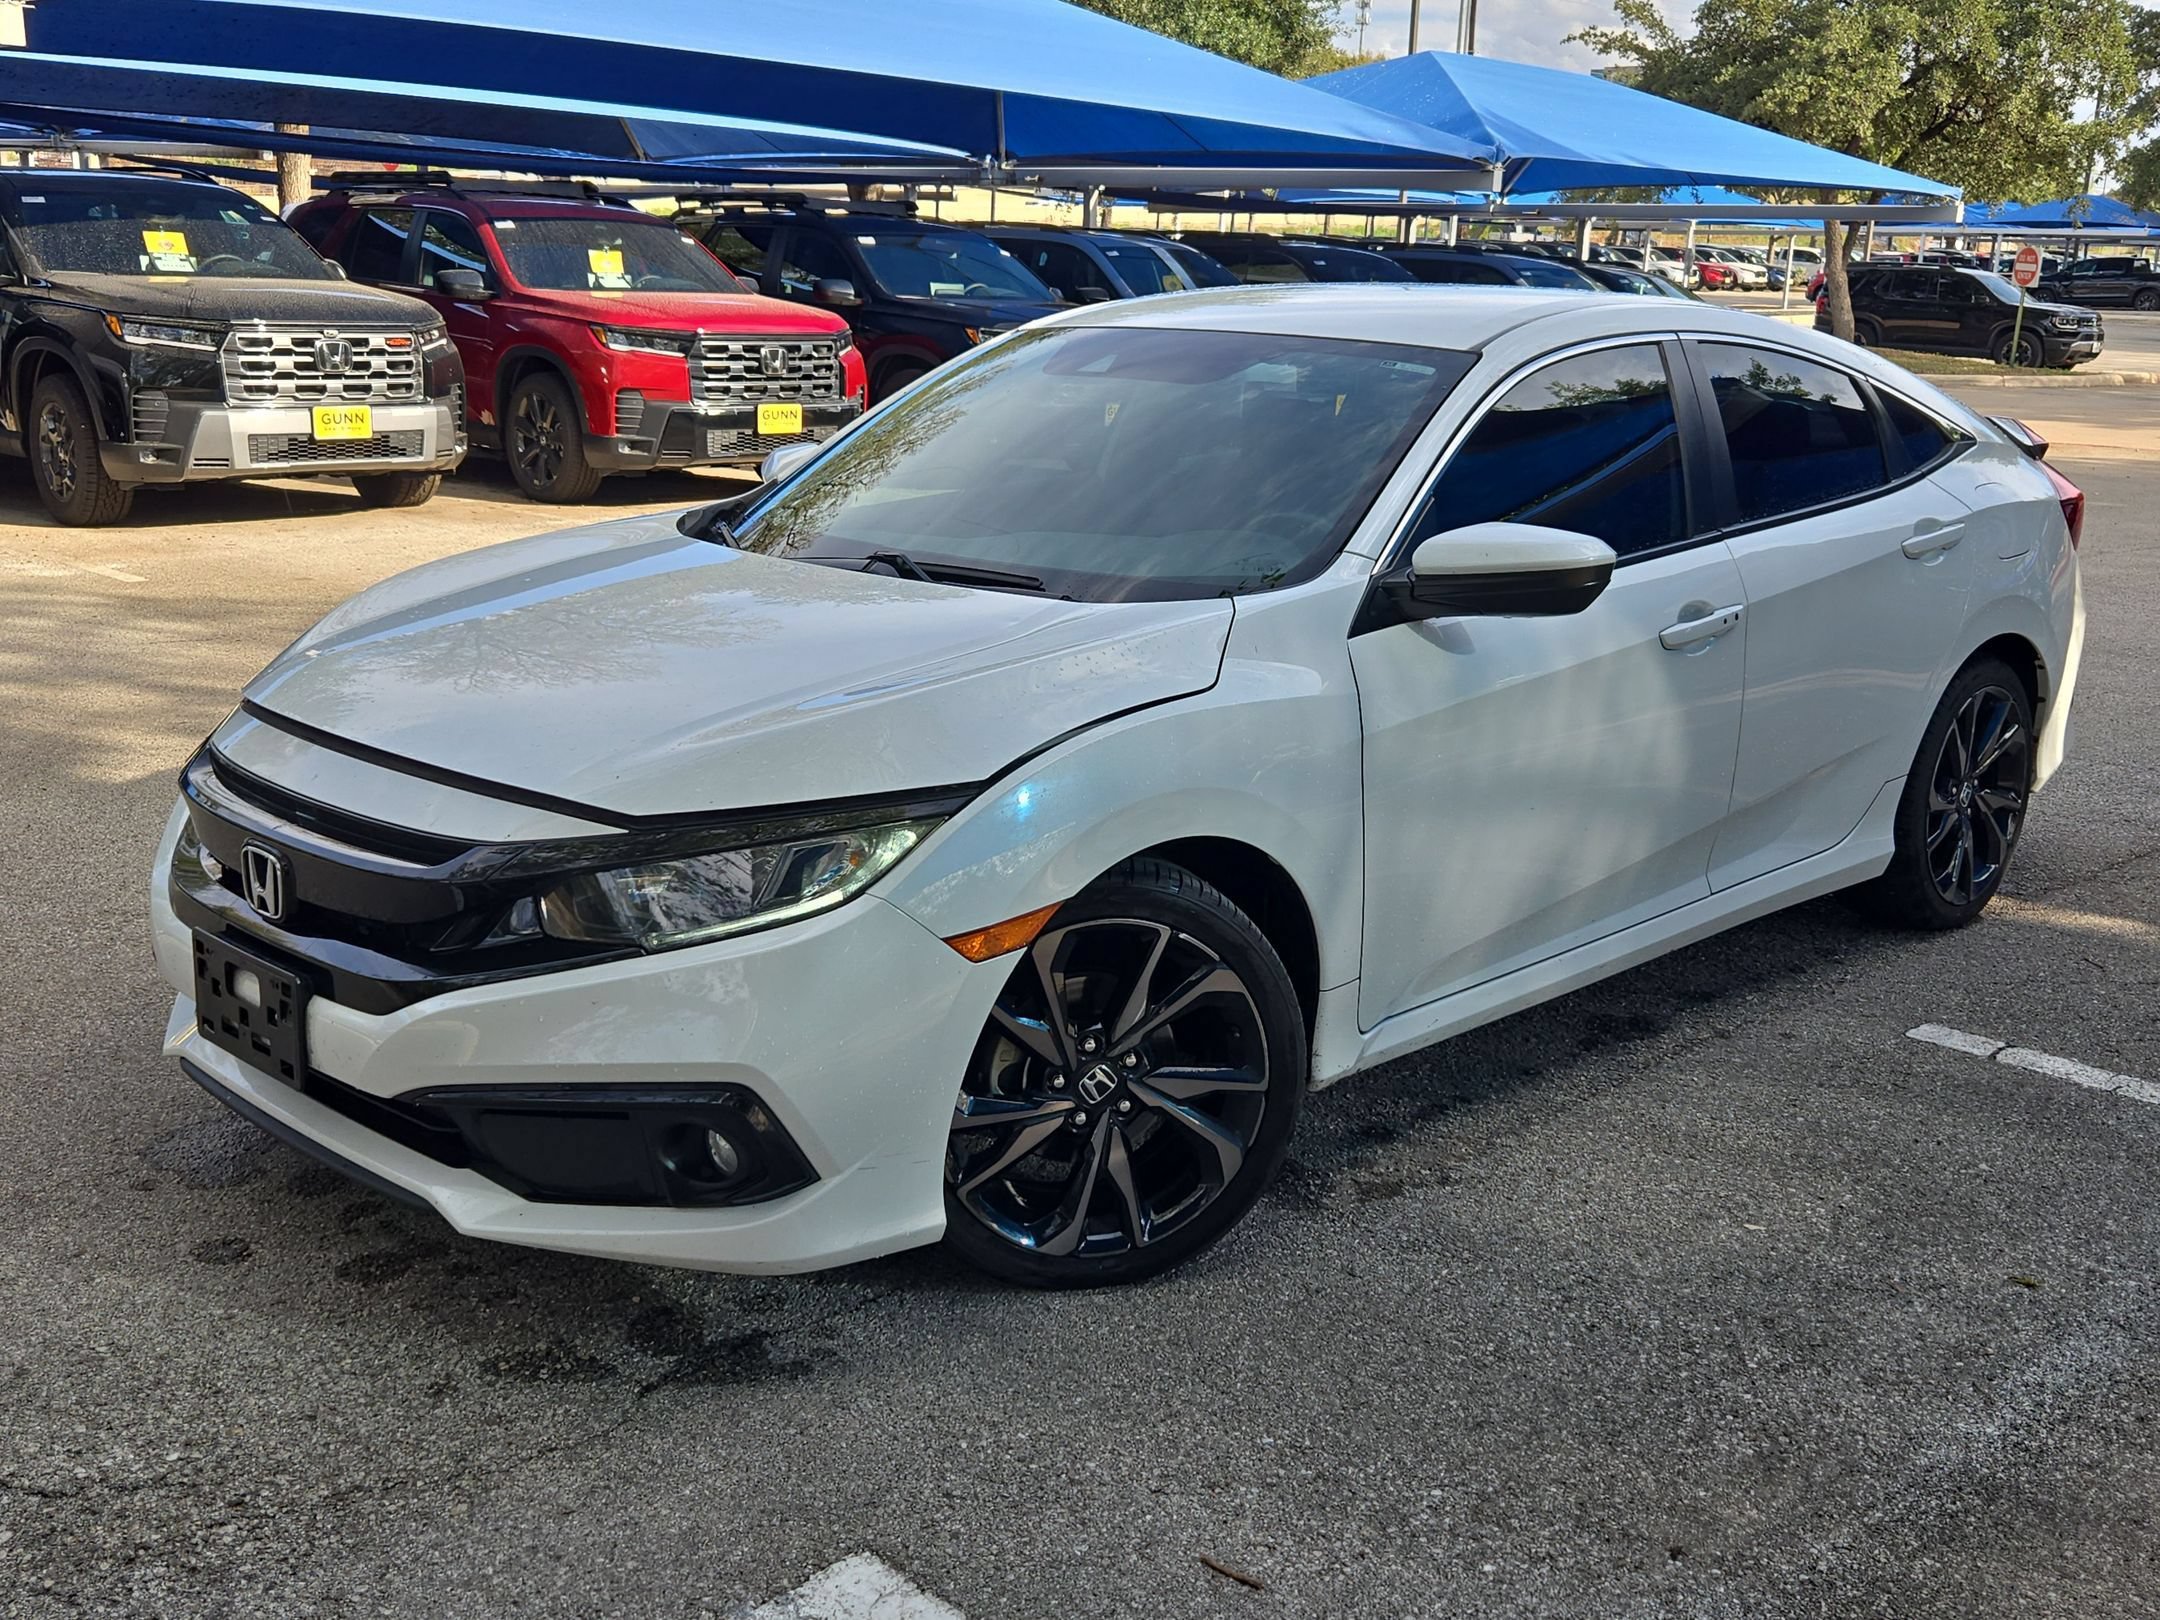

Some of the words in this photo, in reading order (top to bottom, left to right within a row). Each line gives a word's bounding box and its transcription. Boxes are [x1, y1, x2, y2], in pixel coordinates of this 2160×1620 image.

[2018, 254, 2026, 262] DO
[2017, 271, 2032, 279] ENTER
[321, 412, 365, 425] GUNN
[762, 410, 798, 420] GUNN
